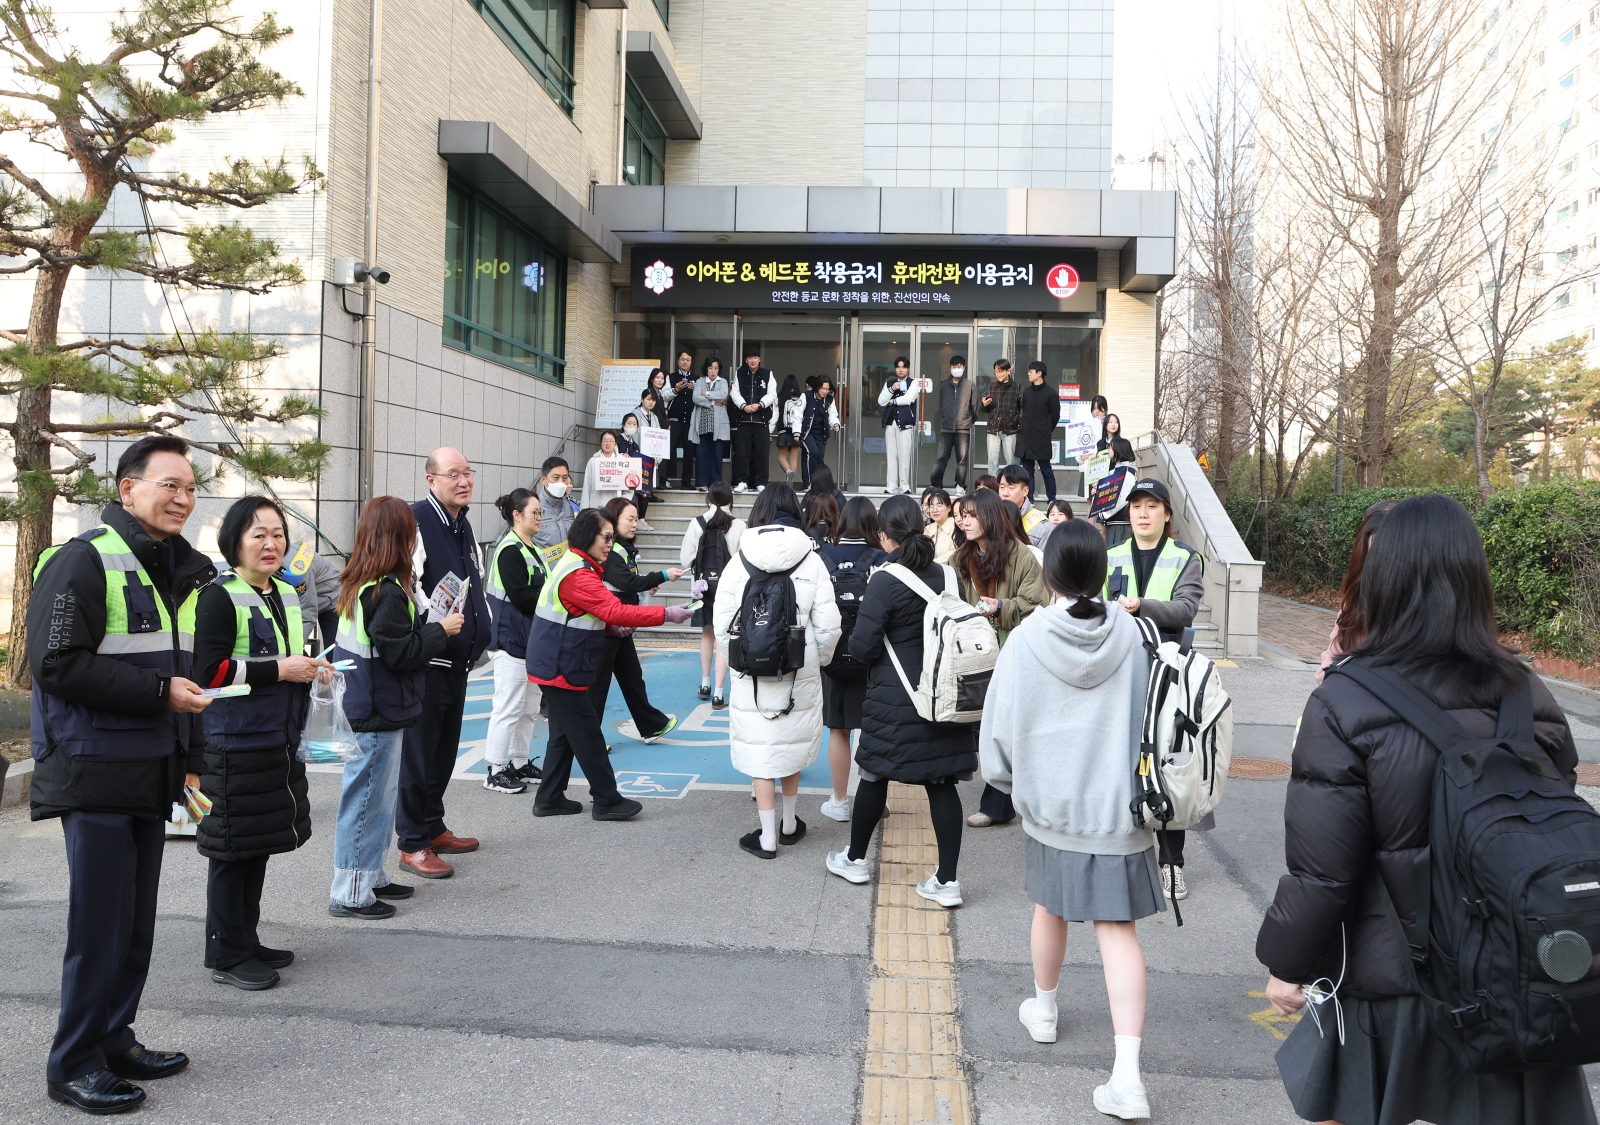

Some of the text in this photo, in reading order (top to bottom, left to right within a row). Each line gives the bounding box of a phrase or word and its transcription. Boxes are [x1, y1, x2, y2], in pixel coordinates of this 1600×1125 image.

[687, 261, 1033, 286] 이어폰 & 헤드폰 착용금지 휴대전화 이용금지
[772, 291, 798, 302] 안전한
[801, 291, 819, 302] 등교
[821, 291, 840, 302] 문화
[842, 292, 869, 303] 정착을
[894, 292, 931, 304] 진선인의
[932, 292, 951, 304] 약속
